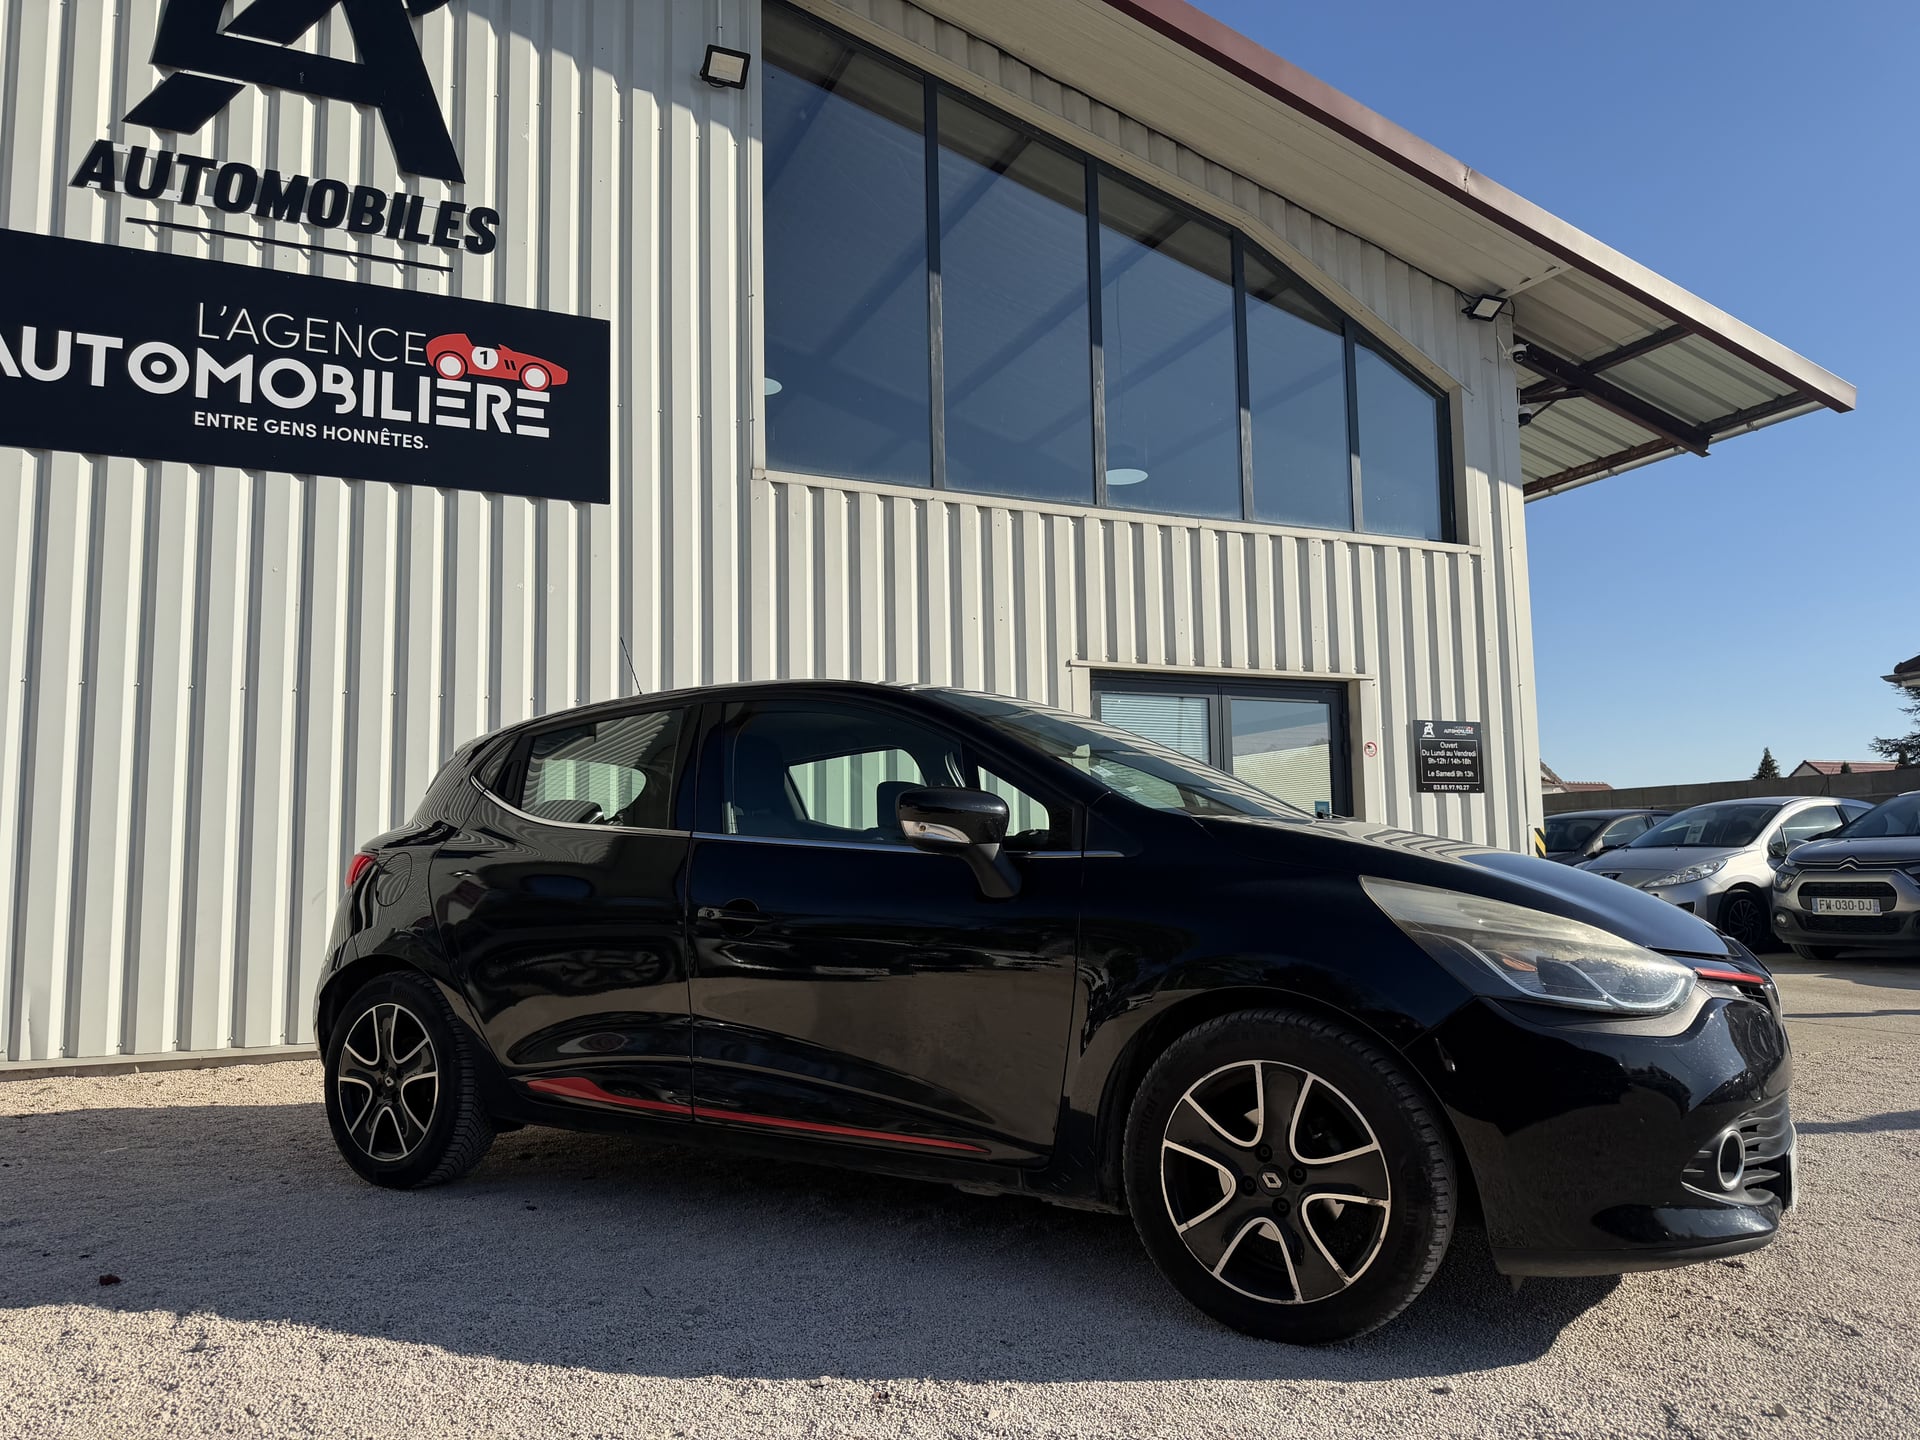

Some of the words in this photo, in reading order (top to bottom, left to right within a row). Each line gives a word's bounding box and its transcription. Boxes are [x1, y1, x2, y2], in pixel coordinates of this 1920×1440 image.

[69, 139, 500, 255] AUTOMOBILES
[198, 302, 427, 367] L'AGENCE
[479, 350, 489, 366] 1
[193, 411, 258, 432] ENTRE
[263, 419, 318, 439] GENS
[323, 425, 430, 450] HONNÊTES.
